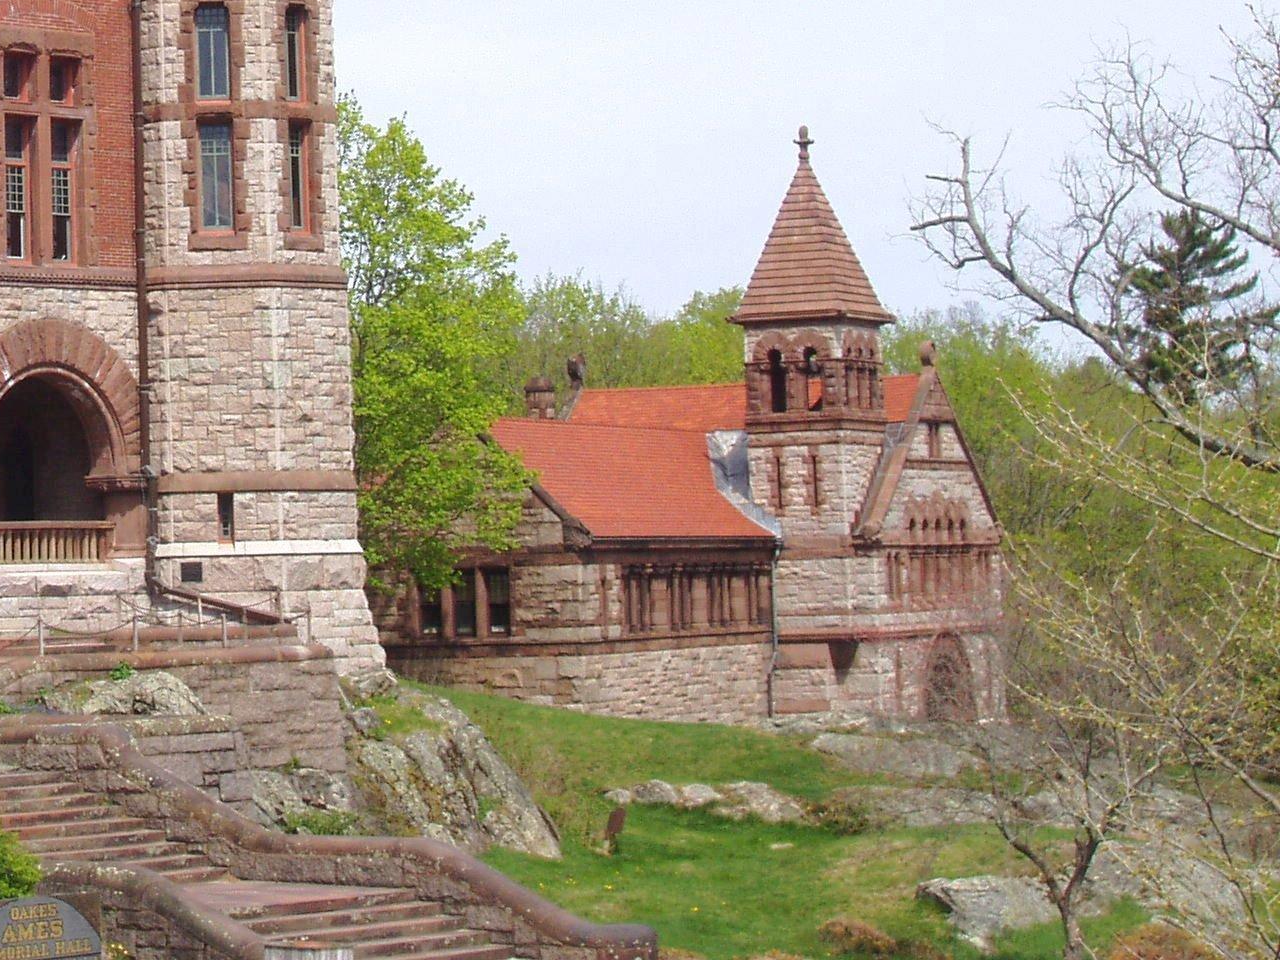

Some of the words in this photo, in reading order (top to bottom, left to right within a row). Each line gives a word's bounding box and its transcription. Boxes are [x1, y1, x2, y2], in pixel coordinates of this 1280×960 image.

[11, 903, 57, 920] OAKES
[2, 920, 63, 943] AMES
[55, 938, 91, 956] HALL
